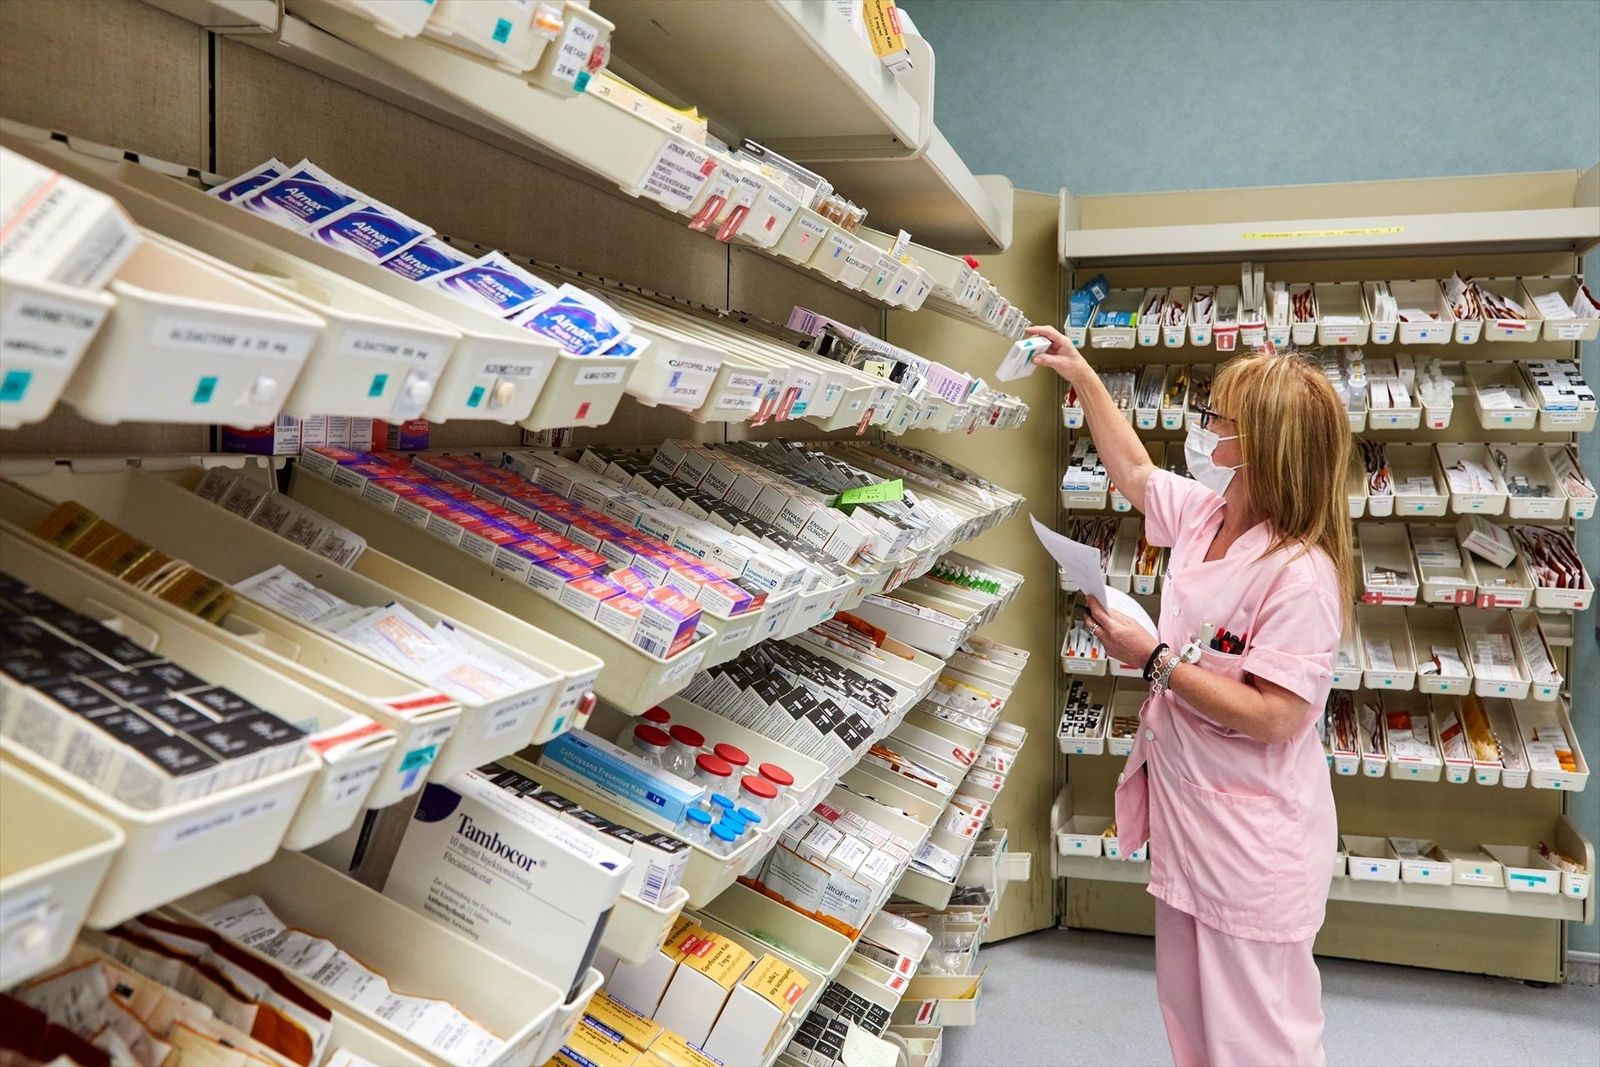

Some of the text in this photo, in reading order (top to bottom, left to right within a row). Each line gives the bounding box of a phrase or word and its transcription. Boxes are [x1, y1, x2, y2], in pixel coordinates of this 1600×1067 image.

[783, 507, 803, 523] ENVASE
[809, 520, 830, 536] ENVASE
[597, 764, 630, 787] Fresenius
[448, 836, 459, 847] 10
[458, 812, 538, 873] Tambocor
